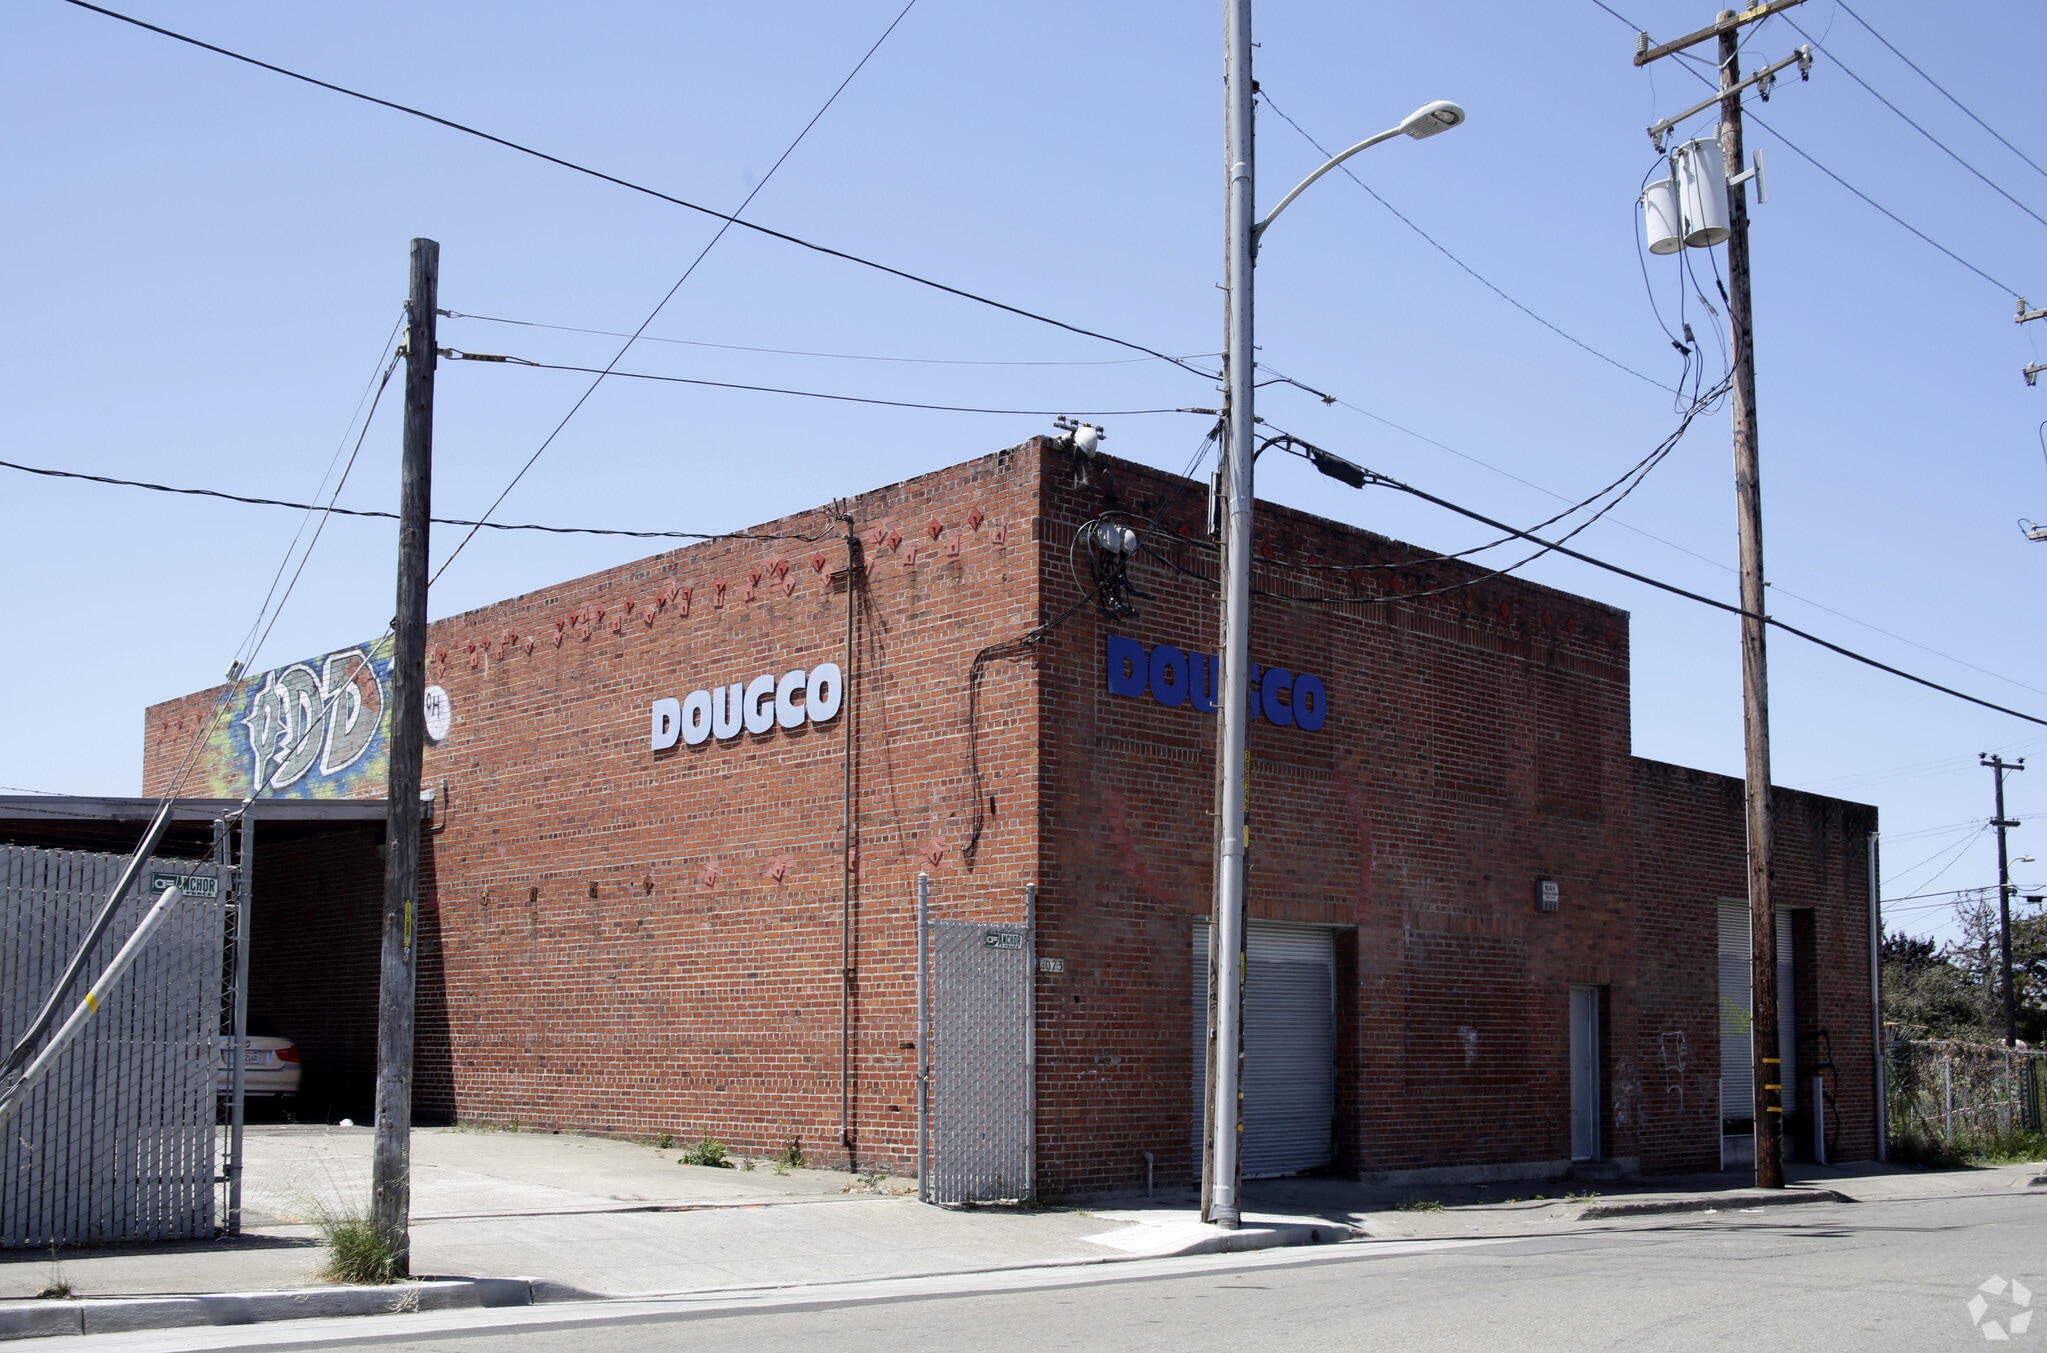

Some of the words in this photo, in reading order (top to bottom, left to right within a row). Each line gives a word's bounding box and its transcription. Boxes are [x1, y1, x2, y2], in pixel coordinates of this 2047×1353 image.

[651, 661, 843, 751] DOUGCO
[1107, 634, 1328, 732] DOUCO
[178, 875, 216, 893] ANCHOR
